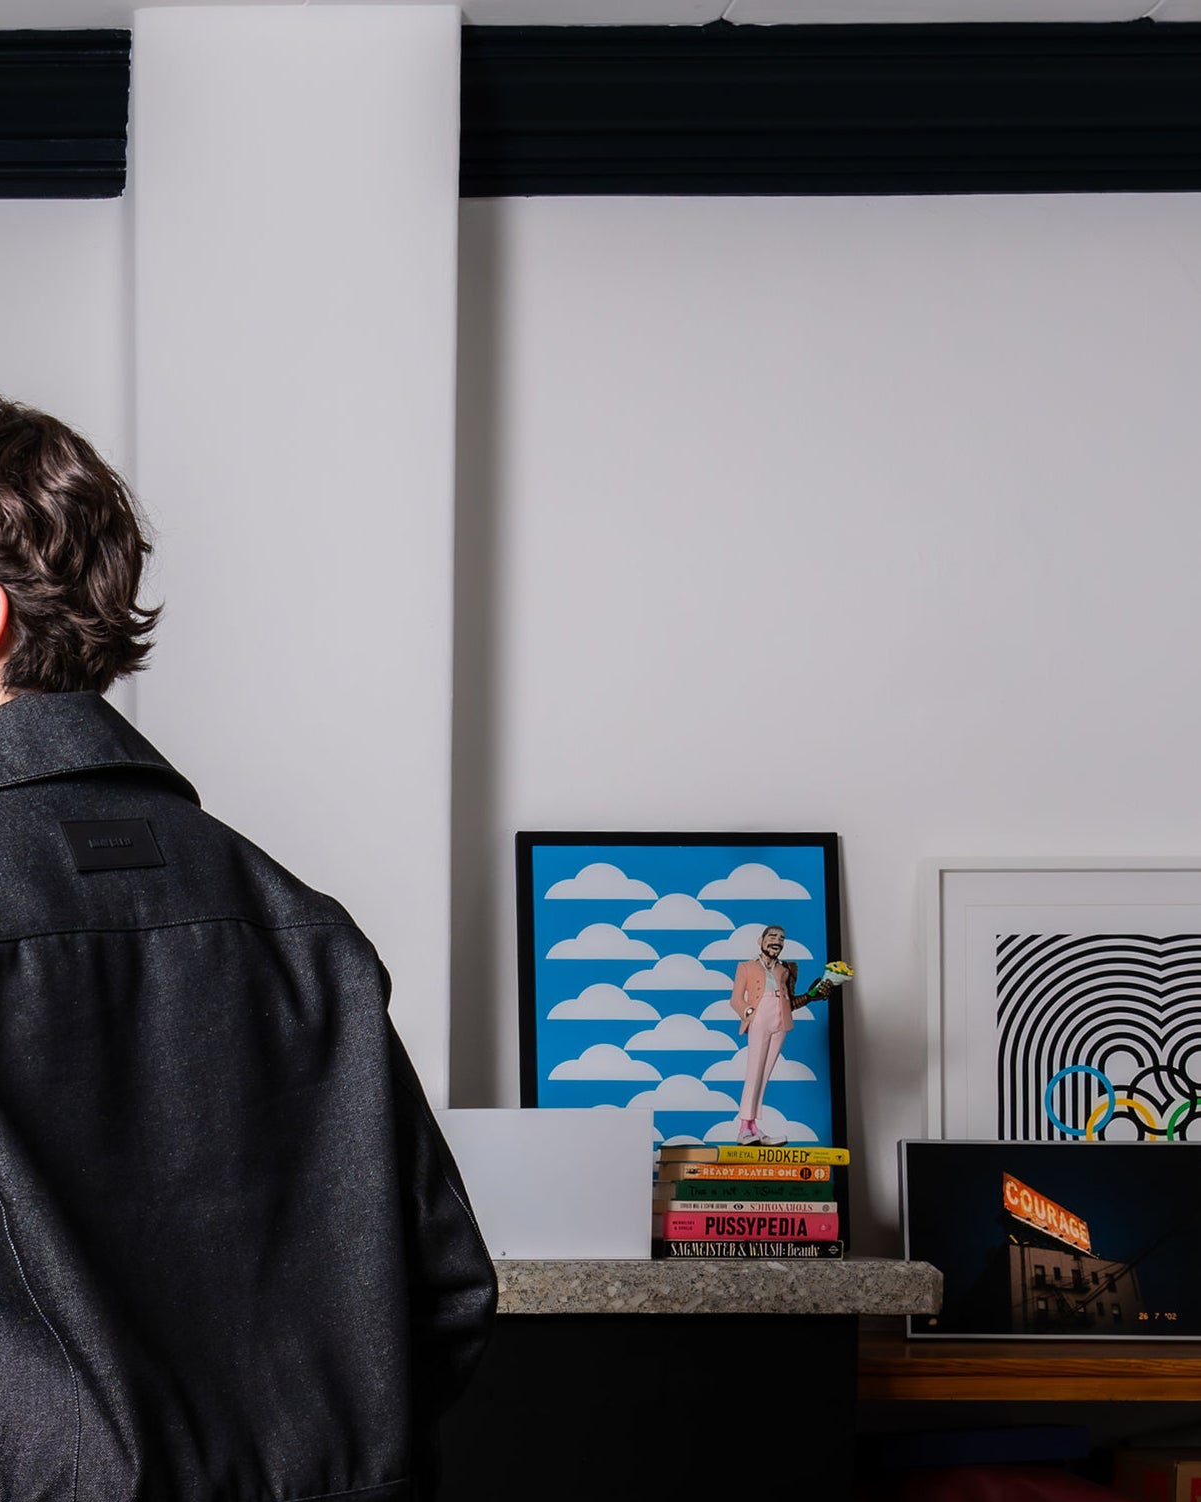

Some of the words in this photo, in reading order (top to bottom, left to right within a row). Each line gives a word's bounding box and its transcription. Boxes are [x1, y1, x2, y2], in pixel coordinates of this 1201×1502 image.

[758, 1149, 809, 1163] HOOKED
[703, 1168, 735, 1176] READY
[739, 1168, 774, 1177] PLAYER
[778, 1168, 798, 1177] ONE
[749, 1203, 814, 1211] STORYNOMICS
[1005, 1180, 1089, 1244] COURAGE
[705, 1216, 807, 1237] PUSSYPEDIA
[671, 1242, 736, 1257] SAGMEISTER
[738, 1242, 747, 1257] &
[749, 1242, 786, 1257] WALSH:
[788, 1243, 820, 1257] Beauty
[1138, 1312, 1148, 1320] 26
[1155, 1312, 1160, 1320] 7
